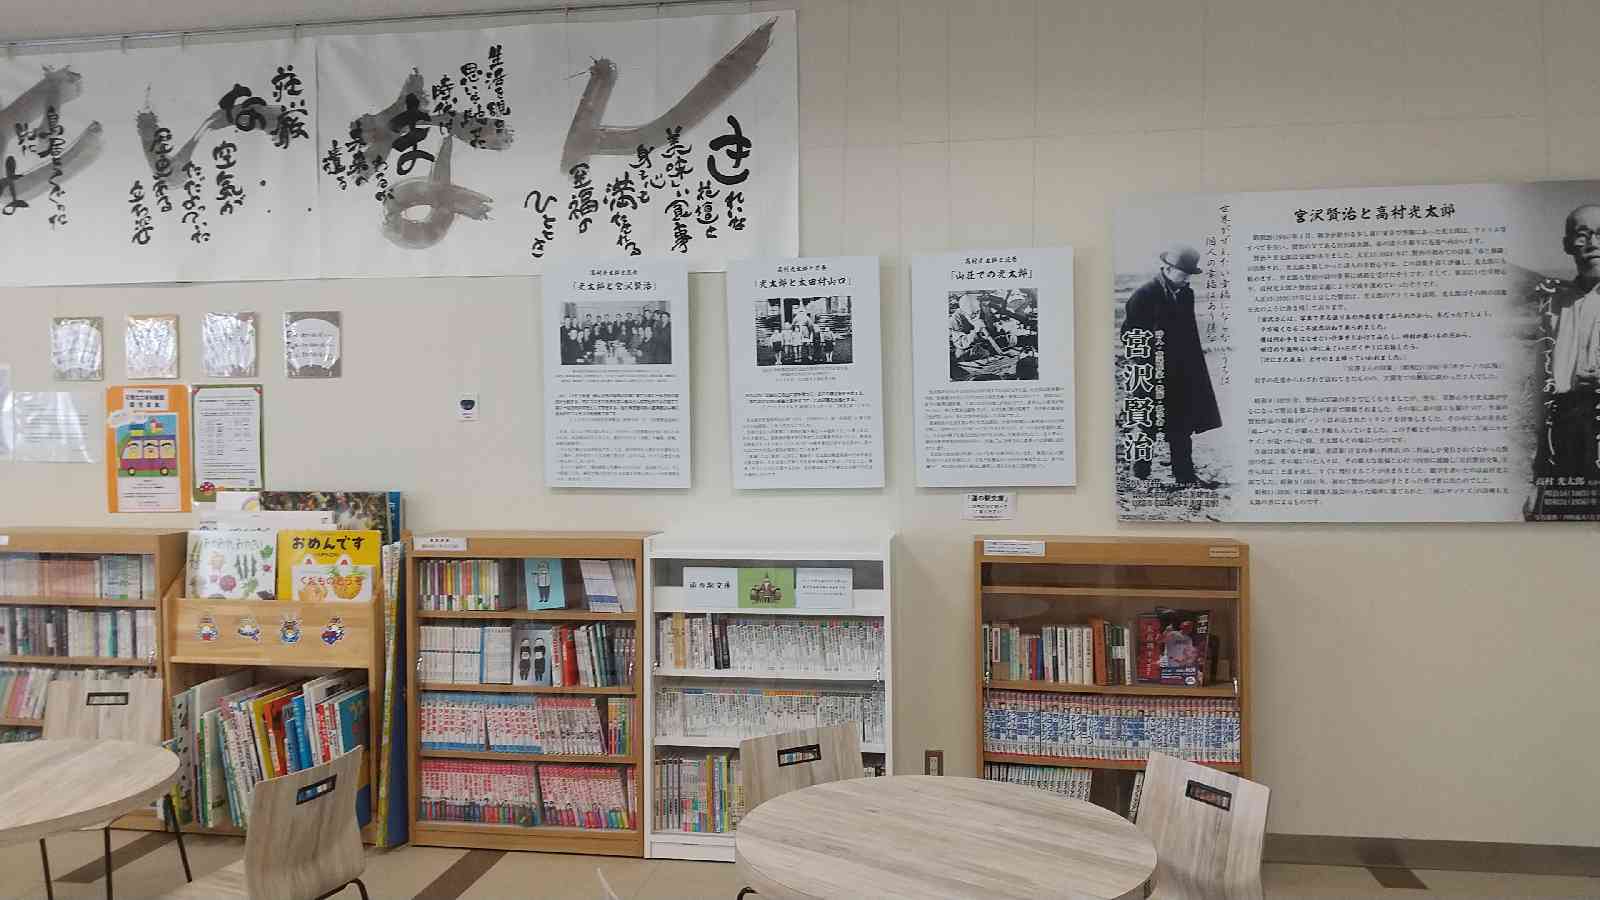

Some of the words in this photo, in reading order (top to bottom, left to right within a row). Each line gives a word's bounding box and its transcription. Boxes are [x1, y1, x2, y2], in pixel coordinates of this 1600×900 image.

[707, 115, 753, 186] き
[1294, 203, 1456, 223] 宮沢賢治と高村光太郎
[1121, 328, 1155, 462] 宮沢賢治
[292, 535, 365, 550] おめんです
